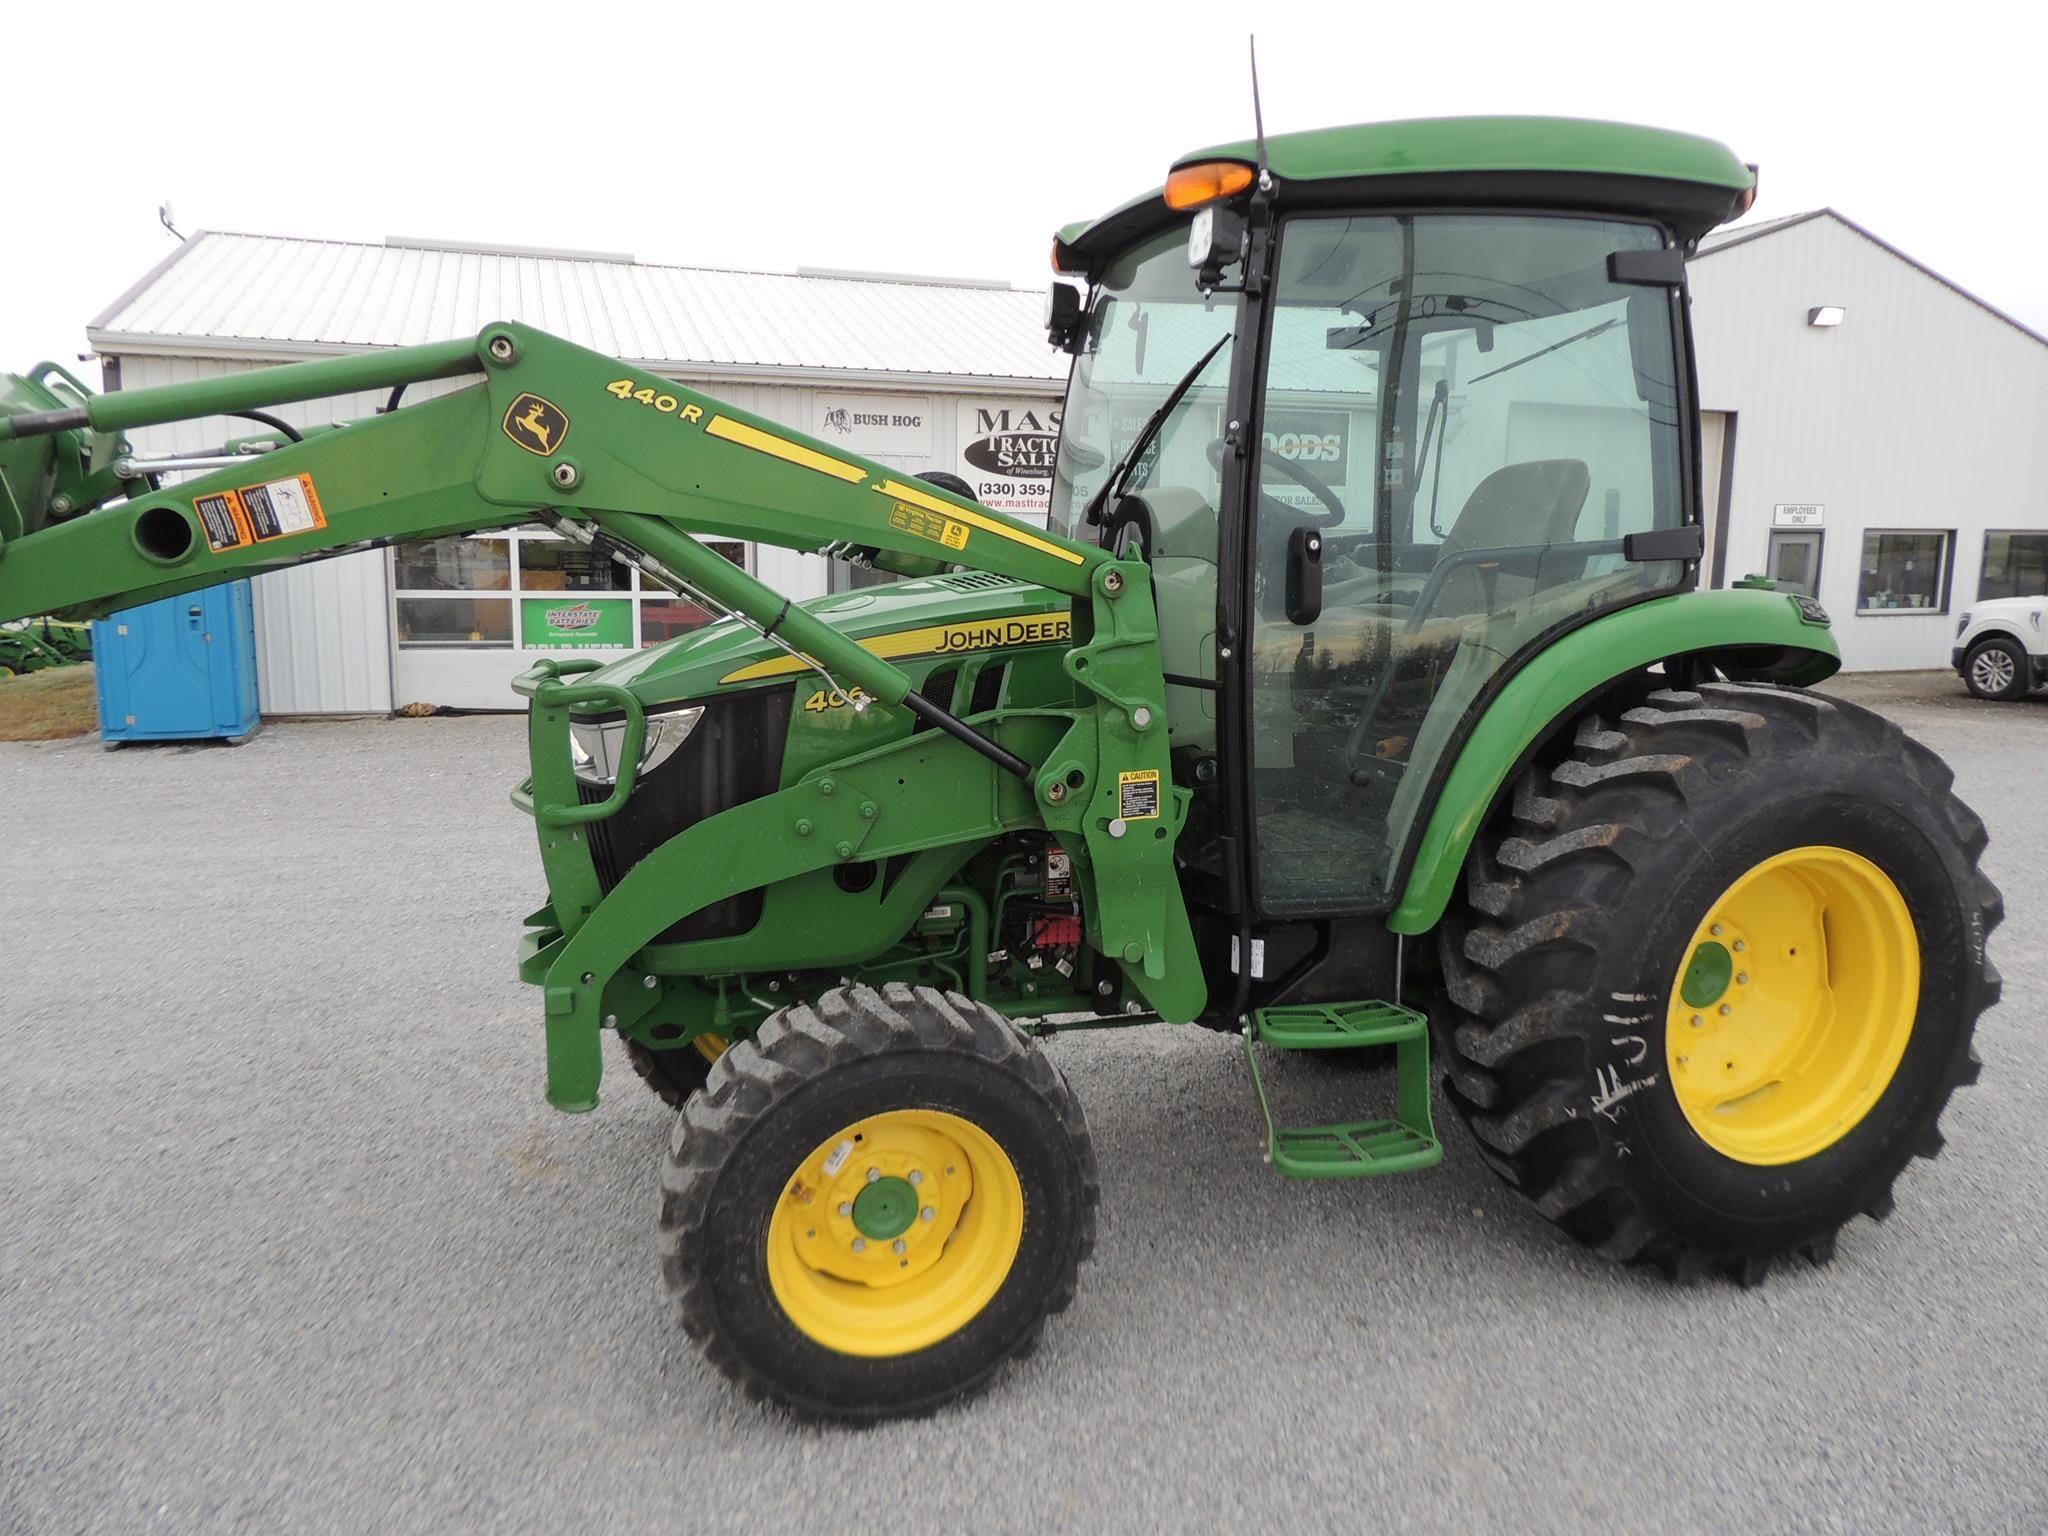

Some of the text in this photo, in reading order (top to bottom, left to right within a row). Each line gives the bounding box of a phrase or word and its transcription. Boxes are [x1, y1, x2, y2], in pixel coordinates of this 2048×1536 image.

[605, 379, 704, 425] 440 R
[853, 413, 922, 427] BUSH HOG
[986, 435, 1058, 453] TRACTO
[1263, 432, 1341, 461] OODS
[998, 451, 1055, 467] SALE
[979, 483, 1015, 497] (330)
[1783, 506, 1817, 515] EMPLOYEES
[1791, 515, 1807, 523] ONLY
[935, 621, 1071, 651] JOHN DEER
[804, 685, 879, 713] 406
[1130, 771, 1157, 780] CAUTION
